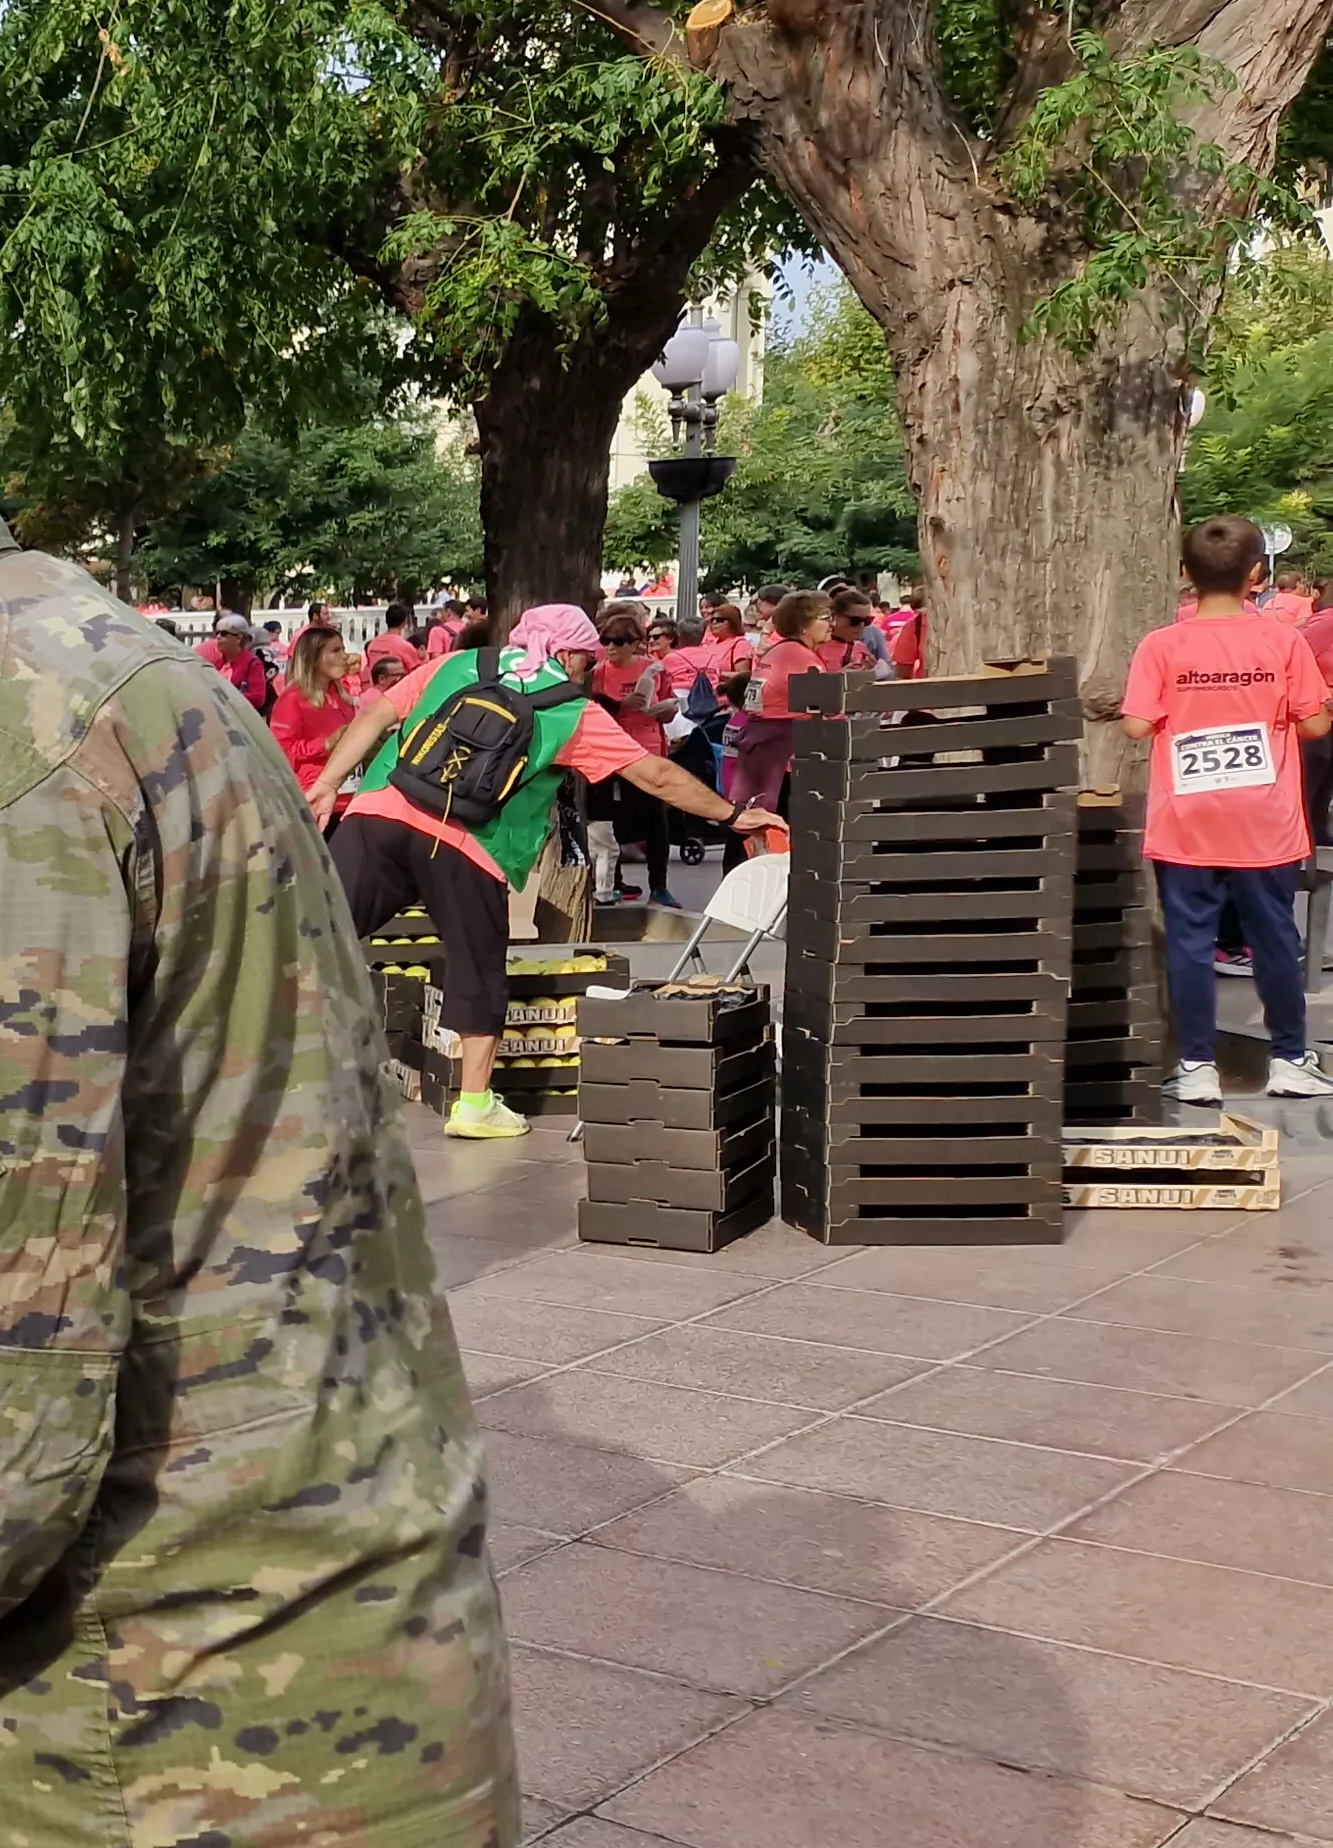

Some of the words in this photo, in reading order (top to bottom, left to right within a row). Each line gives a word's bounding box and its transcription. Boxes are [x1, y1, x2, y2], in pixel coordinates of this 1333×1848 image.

[1176, 667, 1275, 686] altoaragôn
[410, 722, 448, 766] NIKONISTAS
[1181, 745, 1263, 776] 2528
[498, 1038, 566, 1053] SANUI
[1095, 1149, 1191, 1165] SANUI
[1099, 1188, 1194, 1204] SANUI
